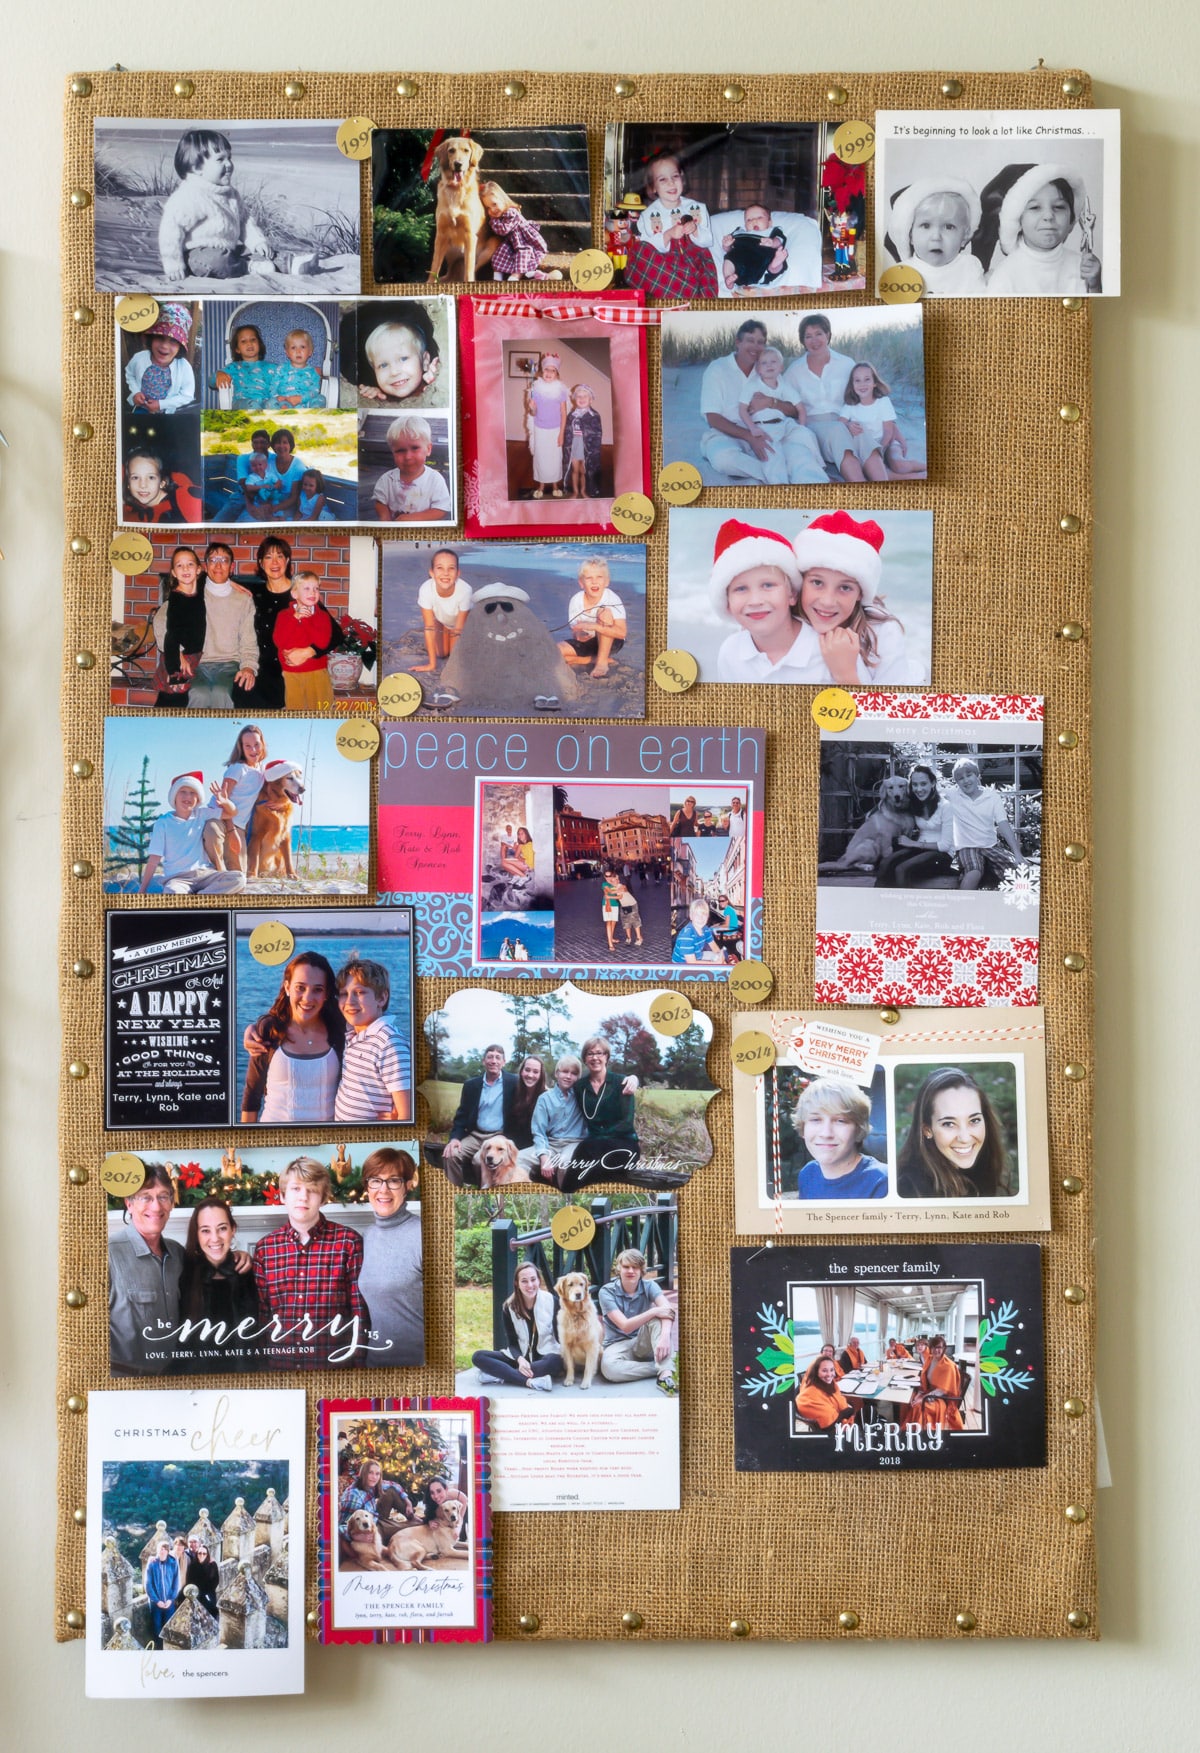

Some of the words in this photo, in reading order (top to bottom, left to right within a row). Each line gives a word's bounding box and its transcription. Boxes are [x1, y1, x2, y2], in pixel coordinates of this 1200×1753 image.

[893, 126, 911, 135] It's
[913, 125, 956, 137] beginning
[959, 126, 969, 135] to
[971, 126, 991, 135] look
[1000, 126, 1012, 135] lot
[1016, 126, 1033, 135] like
[342, 125, 374, 155] 199
[837, 131, 875, 160] 1999
[573, 265, 612, 286] 1998
[879, 282, 923, 293] 2000
[119, 302, 156, 326] 2001
[661, 479, 701, 492] 2003
[613, 505, 651, 527] 2002
[111, 550, 151, 563] 2004
[655, 660, 691, 690] 2006
[381, 690, 421, 706] 2005
[817, 702, 854, 721] 2011
[337, 737, 378, 752] 2007
[383, 731, 527, 778] peace
[556, 734, 610, 772] on
[640, 727, 759, 775] earth
[134, 950, 141, 958] A
[144, 943, 168, 956] VERY
[170, 934, 203, 949] MERRY
[253, 940, 290, 954] 2012
[112, 948, 228, 988] CHRISTMAS
[730, 979, 771, 993] 2009
[130, 991, 143, 1017] A
[148, 990, 210, 1016] HAPPY
[652, 1006, 691, 1024] 2013
[117, 1020, 163, 1030] NEW
[168, 1019, 221, 1030] YEAR
[816, 1025, 847, 1037] WISHING
[849, 1033, 864, 1041] YOU
[149, 1036, 189, 1047] WISHING
[809, 1037, 834, 1051] VERY
[836, 1044, 869, 1059] MERRY
[122, 1050, 160, 1065] GOOD
[164, 1049, 213, 1064] THINGS
[735, 1046, 771, 1063] 2014
[808, 1047, 864, 1067] CHRISTMAS
[162, 1070, 221, 1078] HOLIDAYS
[112, 1093, 143, 1106] Terry,
[146, 1093, 173, 1105] Lynn,
[177, 1092, 202, 1102] Kate
[205, 1091, 226, 1101] and
[159, 1103, 180, 1112] Rob
[543, 1153, 601, 1180] Merry
[600, 1149, 706, 1171] Christmas
[103, 1170, 142, 1185] 2015
[806, 1212, 823, 1221] The
[825, 1212, 859, 1223] Spencer
[862, 1211, 888, 1223] family
[896, 1211, 922, 1223] Terry,
[925, 1211, 950, 1223] Lynn,
[952, 1211, 972, 1220] Kate
[974, 1210, 990, 1219] and
[993, 1210, 1010, 1219] Rob
[560, 1215, 592, 1245] 2016
[829, 1263, 848, 1274] the
[854, 1264, 900, 1276] spencer
[902, 1261, 940, 1275] family
[157, 1318, 172, 1329] be
[143, 1313, 393, 1362] merry
[225, 1349, 244, 1358] KATE
[254, 1348, 261, 1357] A
[263, 1347, 296, 1356] TEENAGE
[299, 1346, 316, 1355] ROB
[114, 1428, 188, 1438] CHRISTMAS
[190, 1394, 281, 1465] cheer
[834, 1422, 944, 1452] MERRY
[879, 1456, 901, 1465] 2018
[342, 1575, 393, 1599] Merry
[398, 1575, 465, 1597] Christmas
[182, 1669, 194, 1678] the
[196, 1670, 230, 1680] spencers
